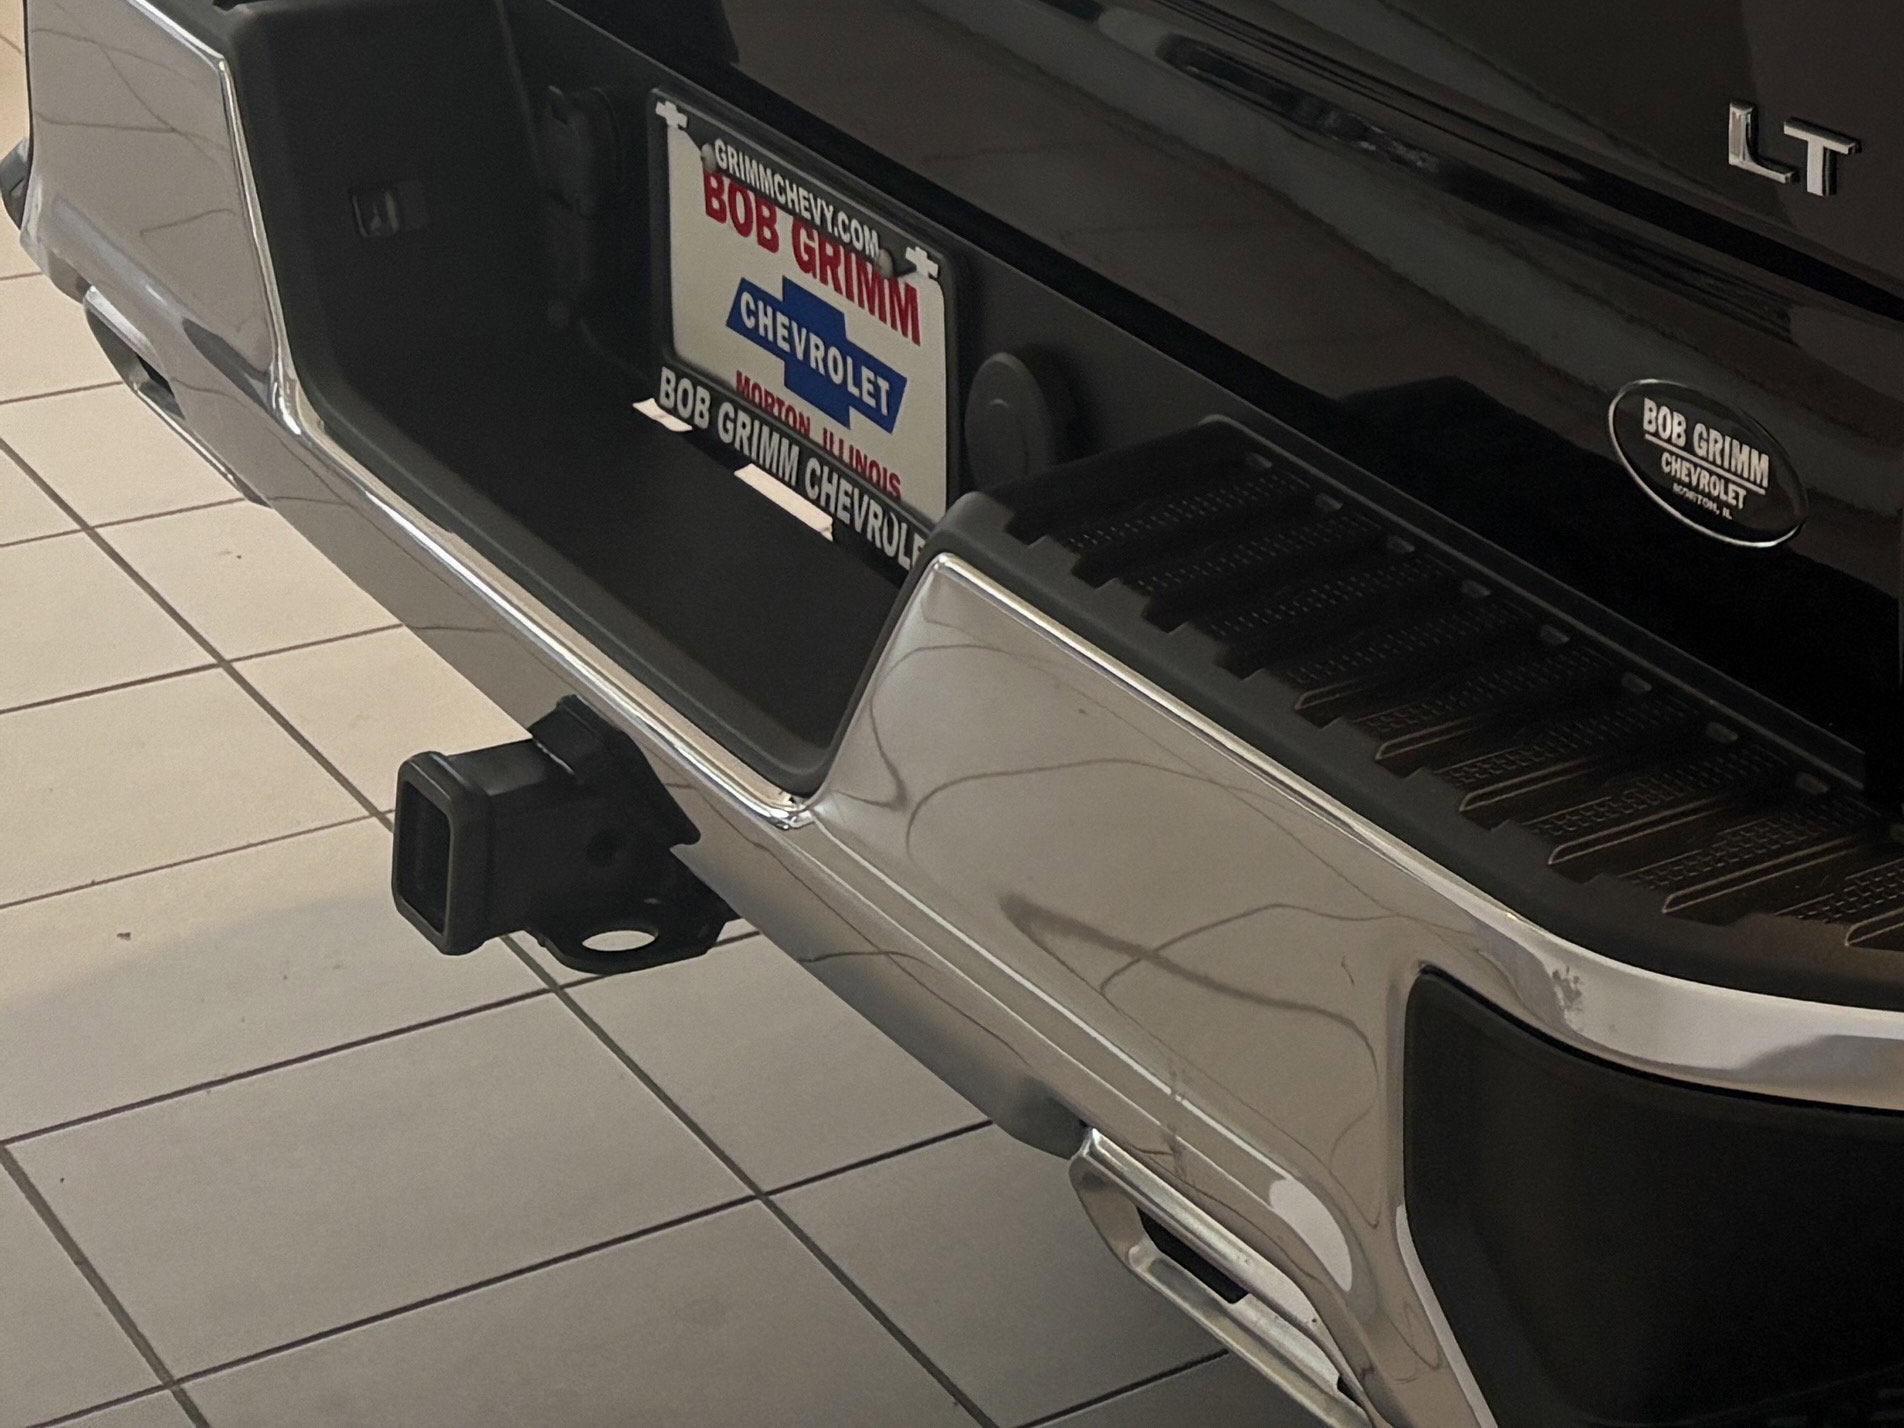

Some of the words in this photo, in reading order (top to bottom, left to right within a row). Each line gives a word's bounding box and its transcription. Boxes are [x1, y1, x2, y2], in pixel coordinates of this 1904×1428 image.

[714, 137, 881, 259] GRIMMCHEVY.COM
[1728, 99, 1860, 197] LT
[702, 170, 780, 254] BOB
[791, 215, 921, 347] GRIMM
[740, 291, 890, 417] CHEVROLET
[658, 366, 711, 430] BOB
[716, 401, 799, 487] GRIMM
[803, 457, 926, 571] CHEVROLE
[736, 369, 811, 440] MORTON
[822, 427, 902, 499] ILLINOIS
[1642, 397, 1687, 448] BOB
[1692, 422, 1770, 489] GRIMM
[1660, 451, 1748, 510] CHEVROLET
